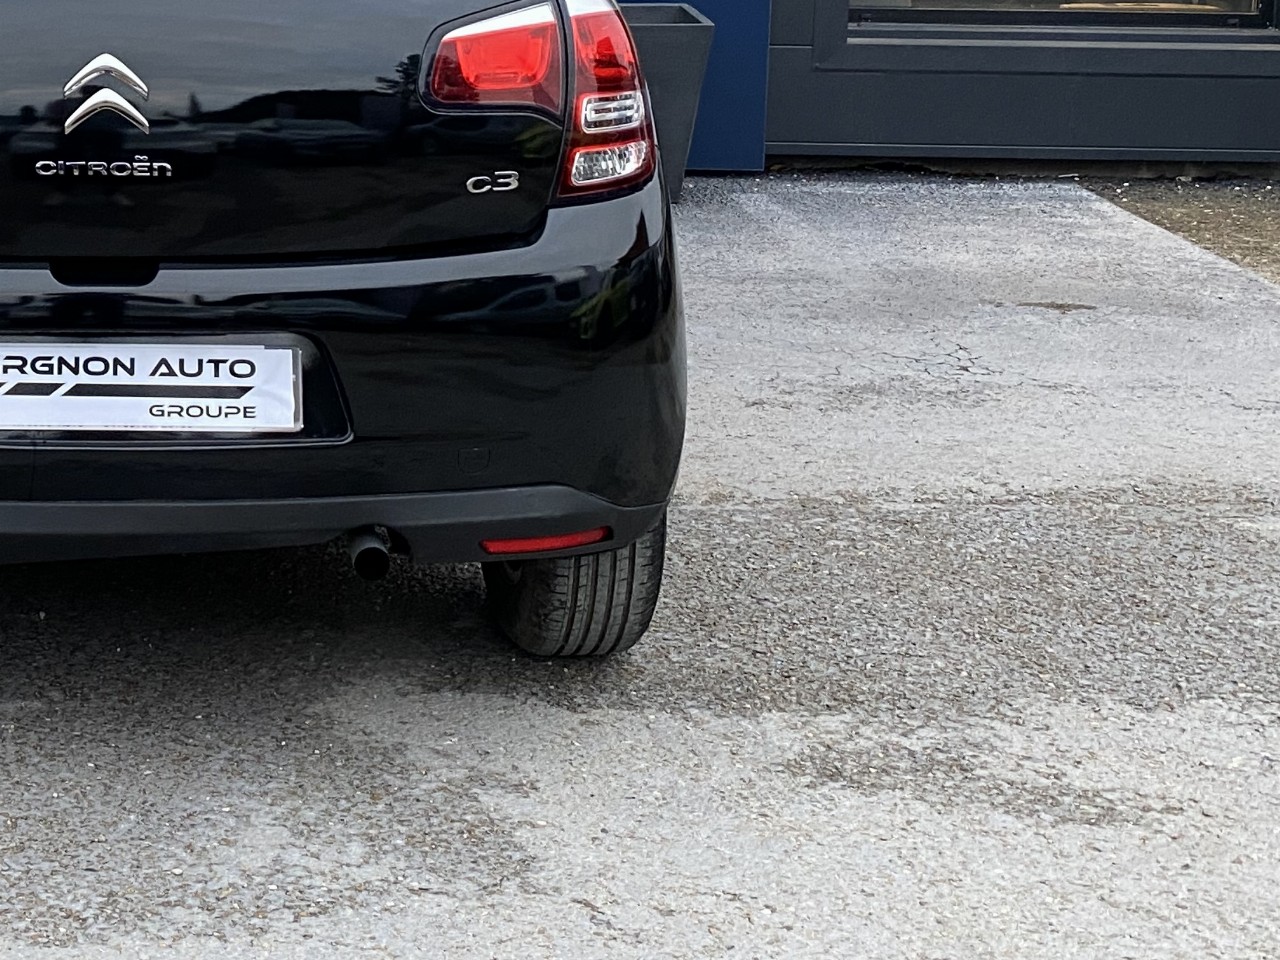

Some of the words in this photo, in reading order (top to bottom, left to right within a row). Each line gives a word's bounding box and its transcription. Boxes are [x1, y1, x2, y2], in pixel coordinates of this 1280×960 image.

[35, 156, 172, 178] CITROËN
[149, 358, 257, 380] AUTO
[148, 405, 257, 419] GROUPE
